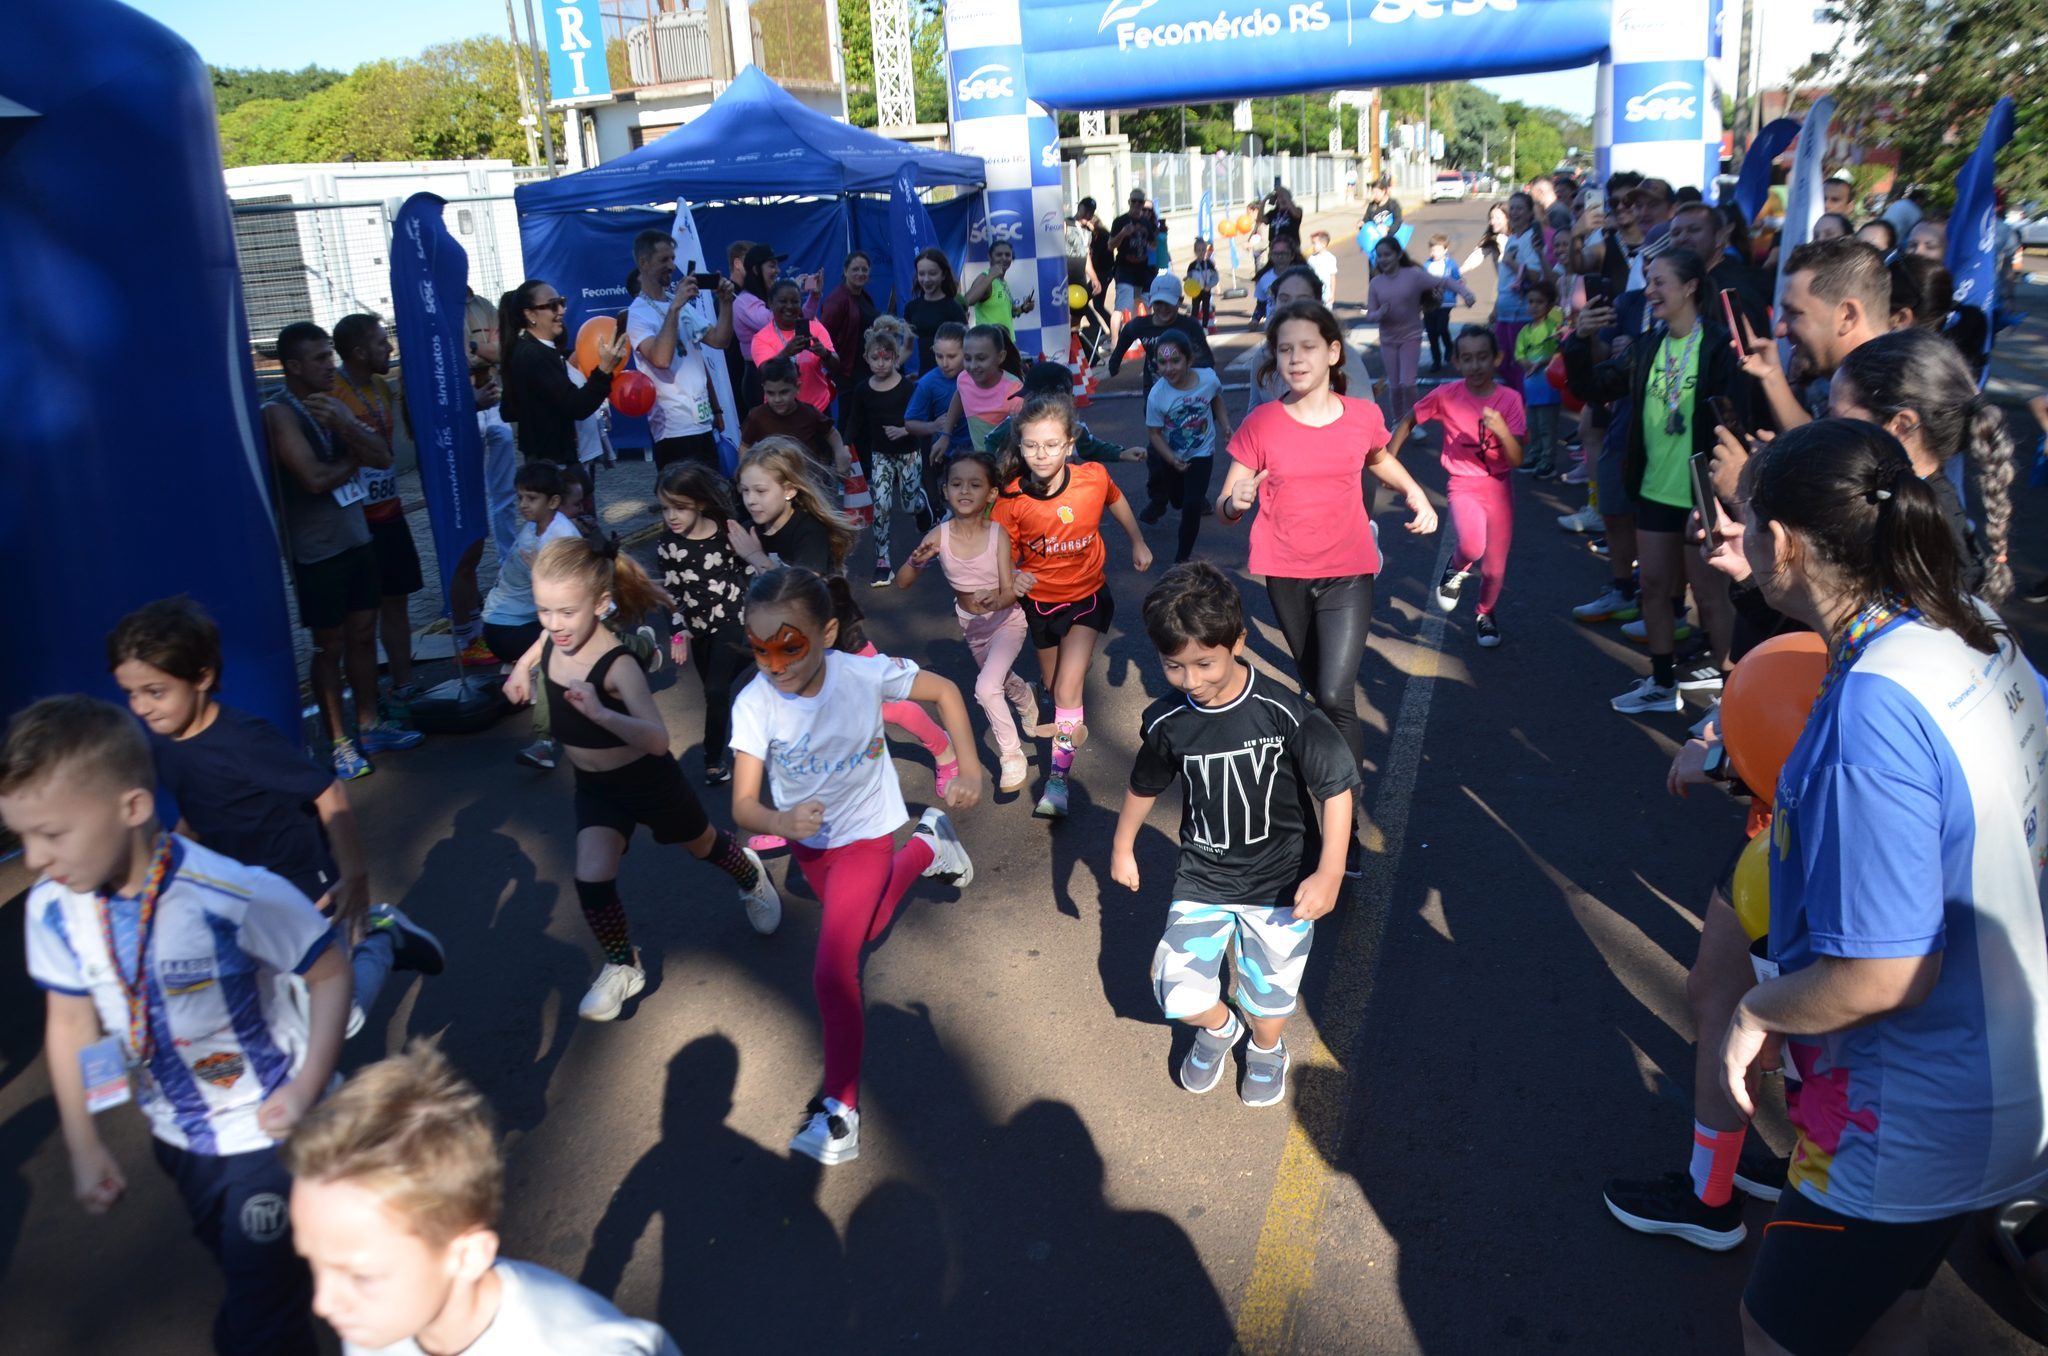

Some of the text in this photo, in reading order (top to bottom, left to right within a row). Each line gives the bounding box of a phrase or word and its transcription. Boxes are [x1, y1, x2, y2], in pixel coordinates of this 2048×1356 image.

[1116, 8, 1281, 51] Fecomércio
[1289, 1, 1331, 33] RS
[554, 0, 592, 96] RI
[958, 68, 1014, 102] Sesc
[1624, 86, 1697, 122] Sesc
[421, 281, 437, 314] Sesc
[432, 334, 449, 406] Sindicatos
[368, 477, 396, 500] 688
[1183, 742, 1284, 850] NY
